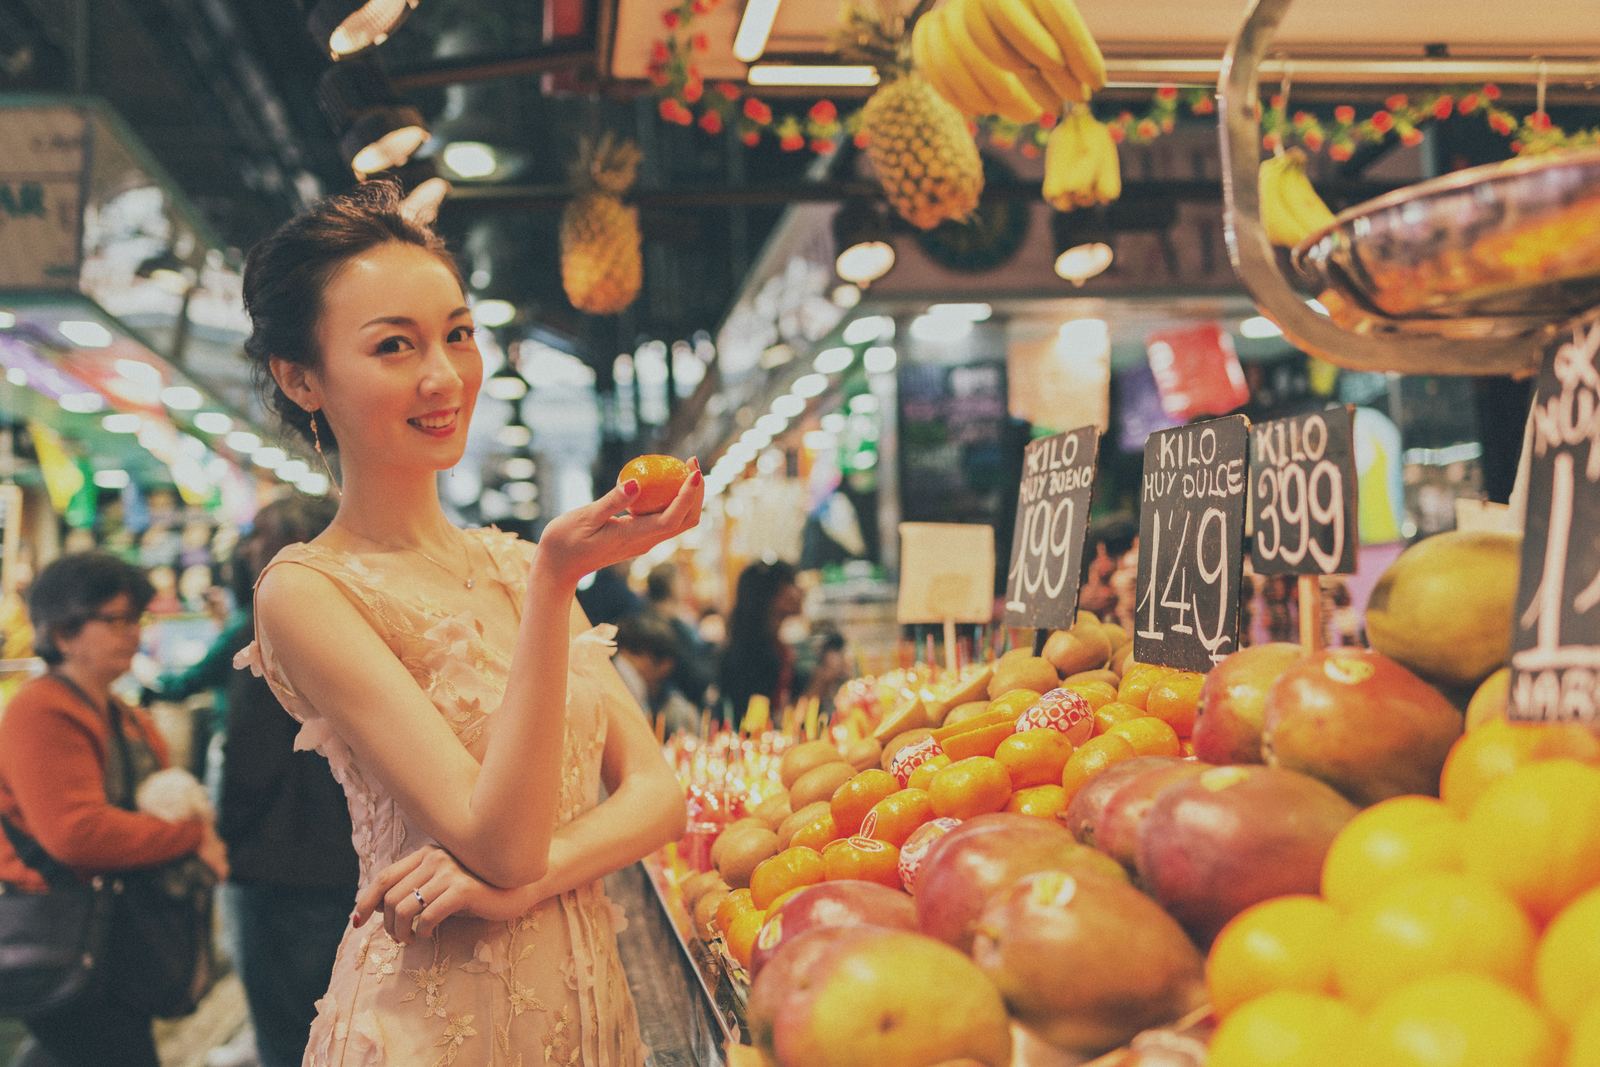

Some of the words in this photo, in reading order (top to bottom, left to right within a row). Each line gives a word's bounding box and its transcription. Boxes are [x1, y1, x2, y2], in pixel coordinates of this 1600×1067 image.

[1028, 434, 1079, 476] KILO
[1160, 428, 1217, 469] KILO
[1257, 414, 1328, 466] KILO
[1049, 466, 1092, 496] BUENO
[1182, 459, 1243, 498] DULCE
